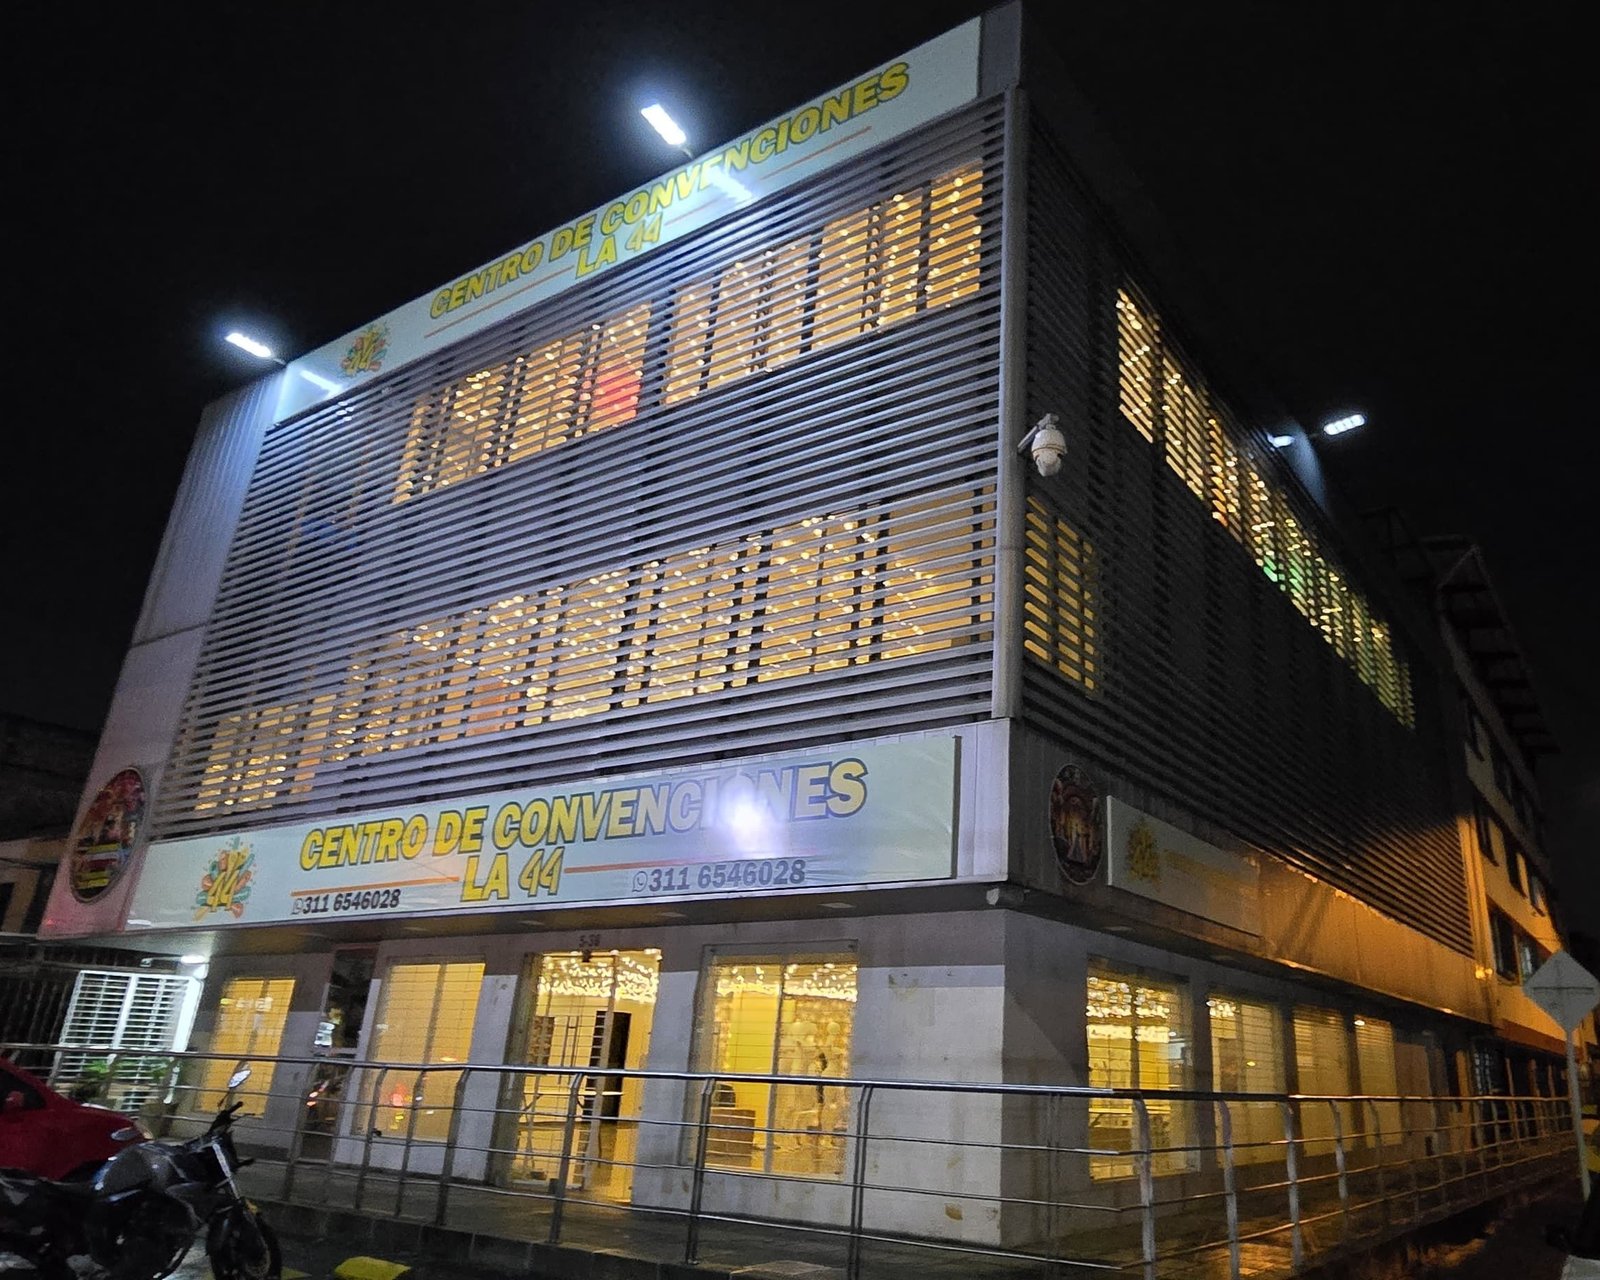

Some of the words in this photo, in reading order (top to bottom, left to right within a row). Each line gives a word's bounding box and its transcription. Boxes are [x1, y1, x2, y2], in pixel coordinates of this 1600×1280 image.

[430, 242, 545, 319] CENTRO
[549, 214, 597, 262] DE
[600, 62, 909, 235] CONVENCIONES
[575, 235, 617, 279] LA
[625, 211, 663, 251] 44
[300, 814, 427, 870] CENTRO
[432, 806, 489, 857] DE
[492, 758, 868, 850] CONVENCIONES
[302, 894, 330, 914] 311
[333, 889, 401, 911] 6546028
[460, 853, 509, 902] LA
[518, 847, 564, 897] 44
[649, 866, 690, 892] 311
[698, 859, 806, 889] 6546028
